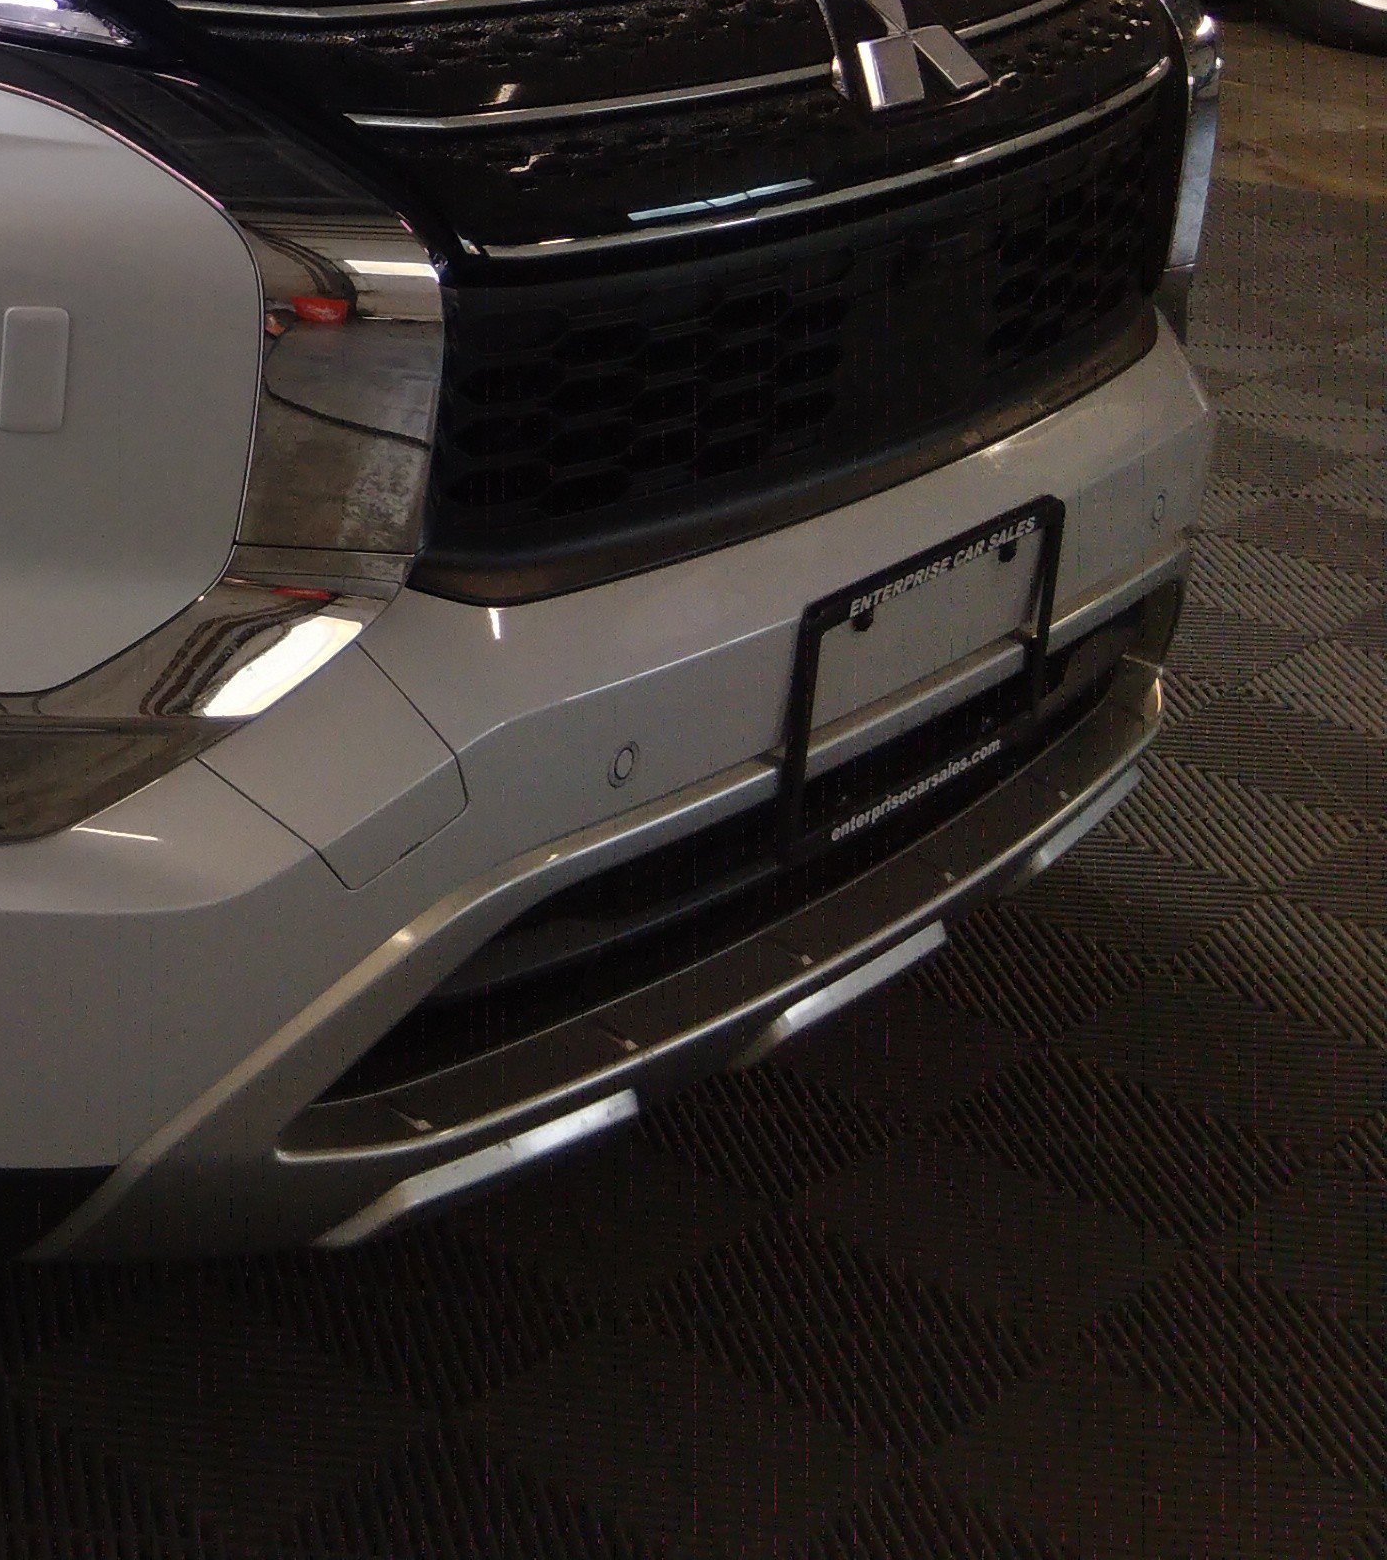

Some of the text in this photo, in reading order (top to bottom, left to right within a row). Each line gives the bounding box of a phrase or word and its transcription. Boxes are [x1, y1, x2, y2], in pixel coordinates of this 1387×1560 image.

[849, 516, 1036, 618] ENTERPRISE CAR SALES
[831, 739, 1001, 841] enterprisecarsales.com
